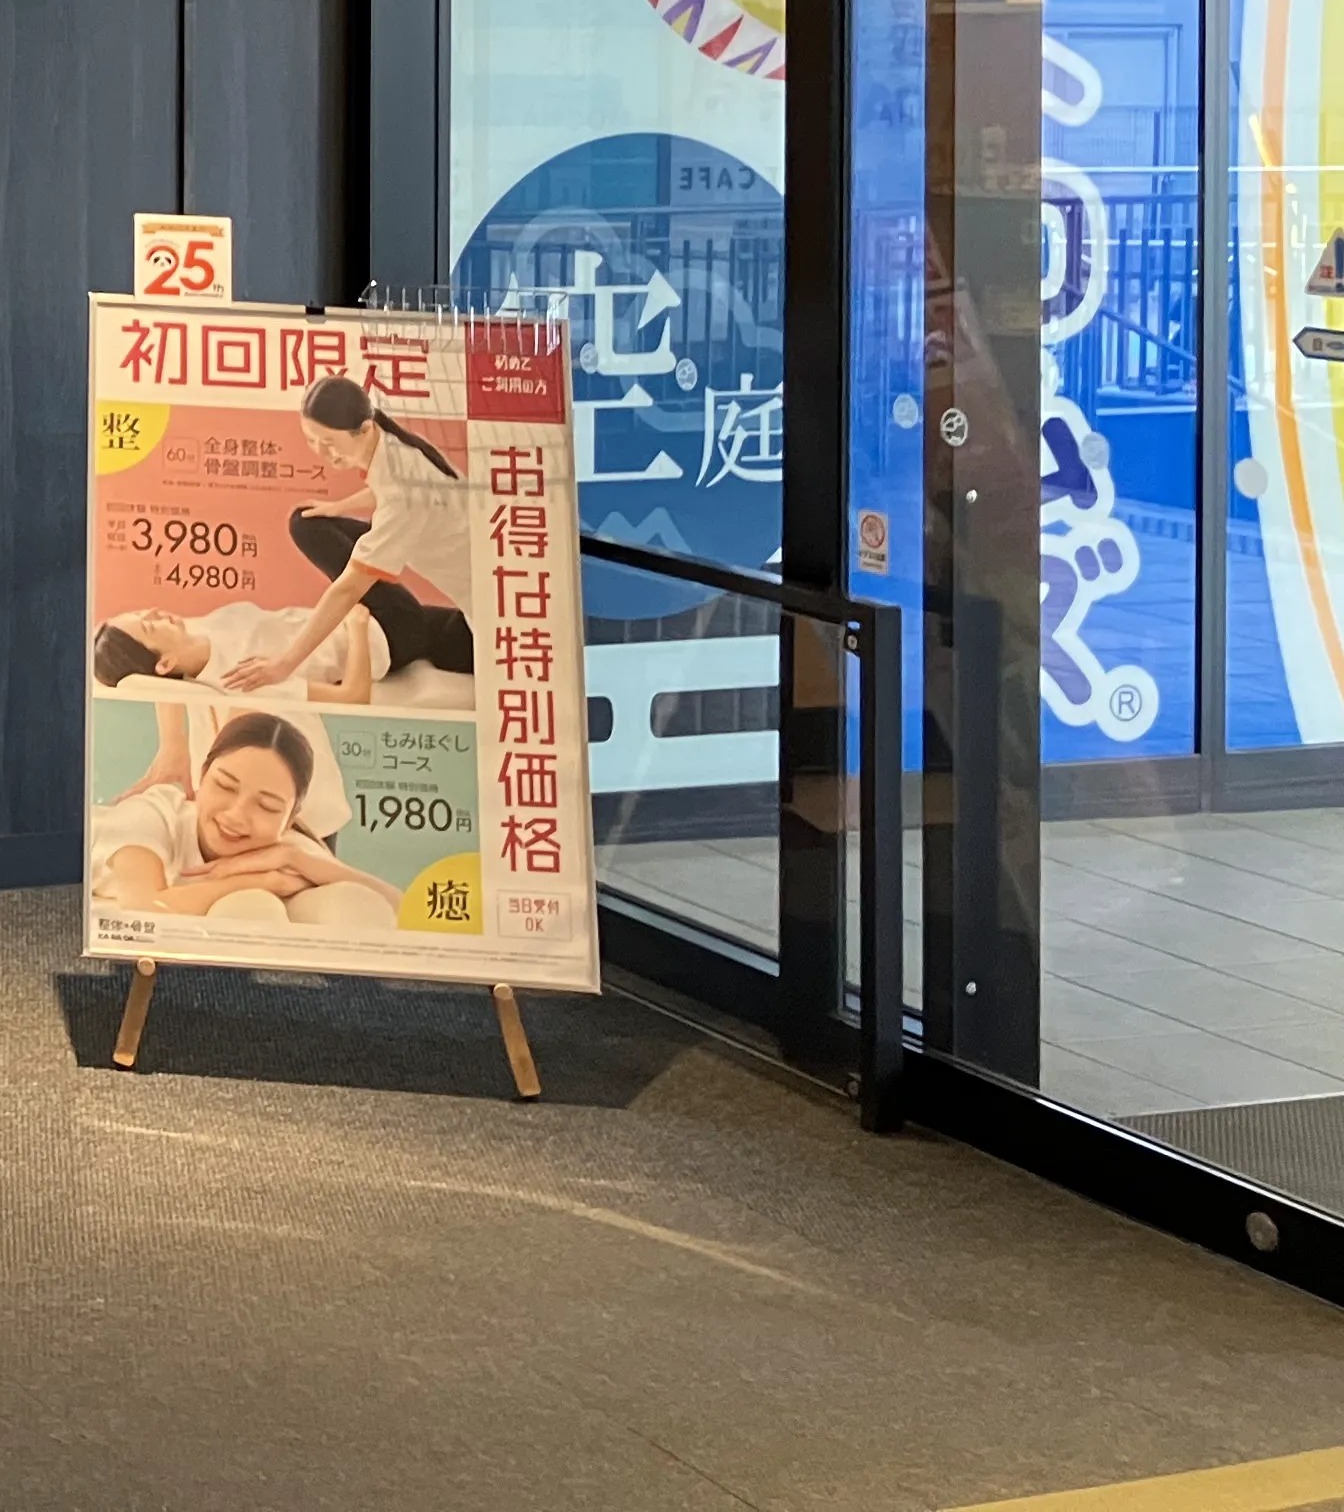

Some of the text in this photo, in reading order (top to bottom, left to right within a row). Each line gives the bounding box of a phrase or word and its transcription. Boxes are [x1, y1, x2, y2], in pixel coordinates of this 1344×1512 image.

[118, 316, 431, 399] 初回限定
[481, 375, 548, 396] ご利用の方
[99, 411, 141, 452] 整
[203, 457, 327, 481] 骨盤調整コース
[487, 445, 562, 874] お得な特別価格
[381, 730, 470, 754] もみほぐし
[382, 755, 433, 773] コース
[426, 878, 471, 923] 癒
[524, 916, 545, 933] OK
